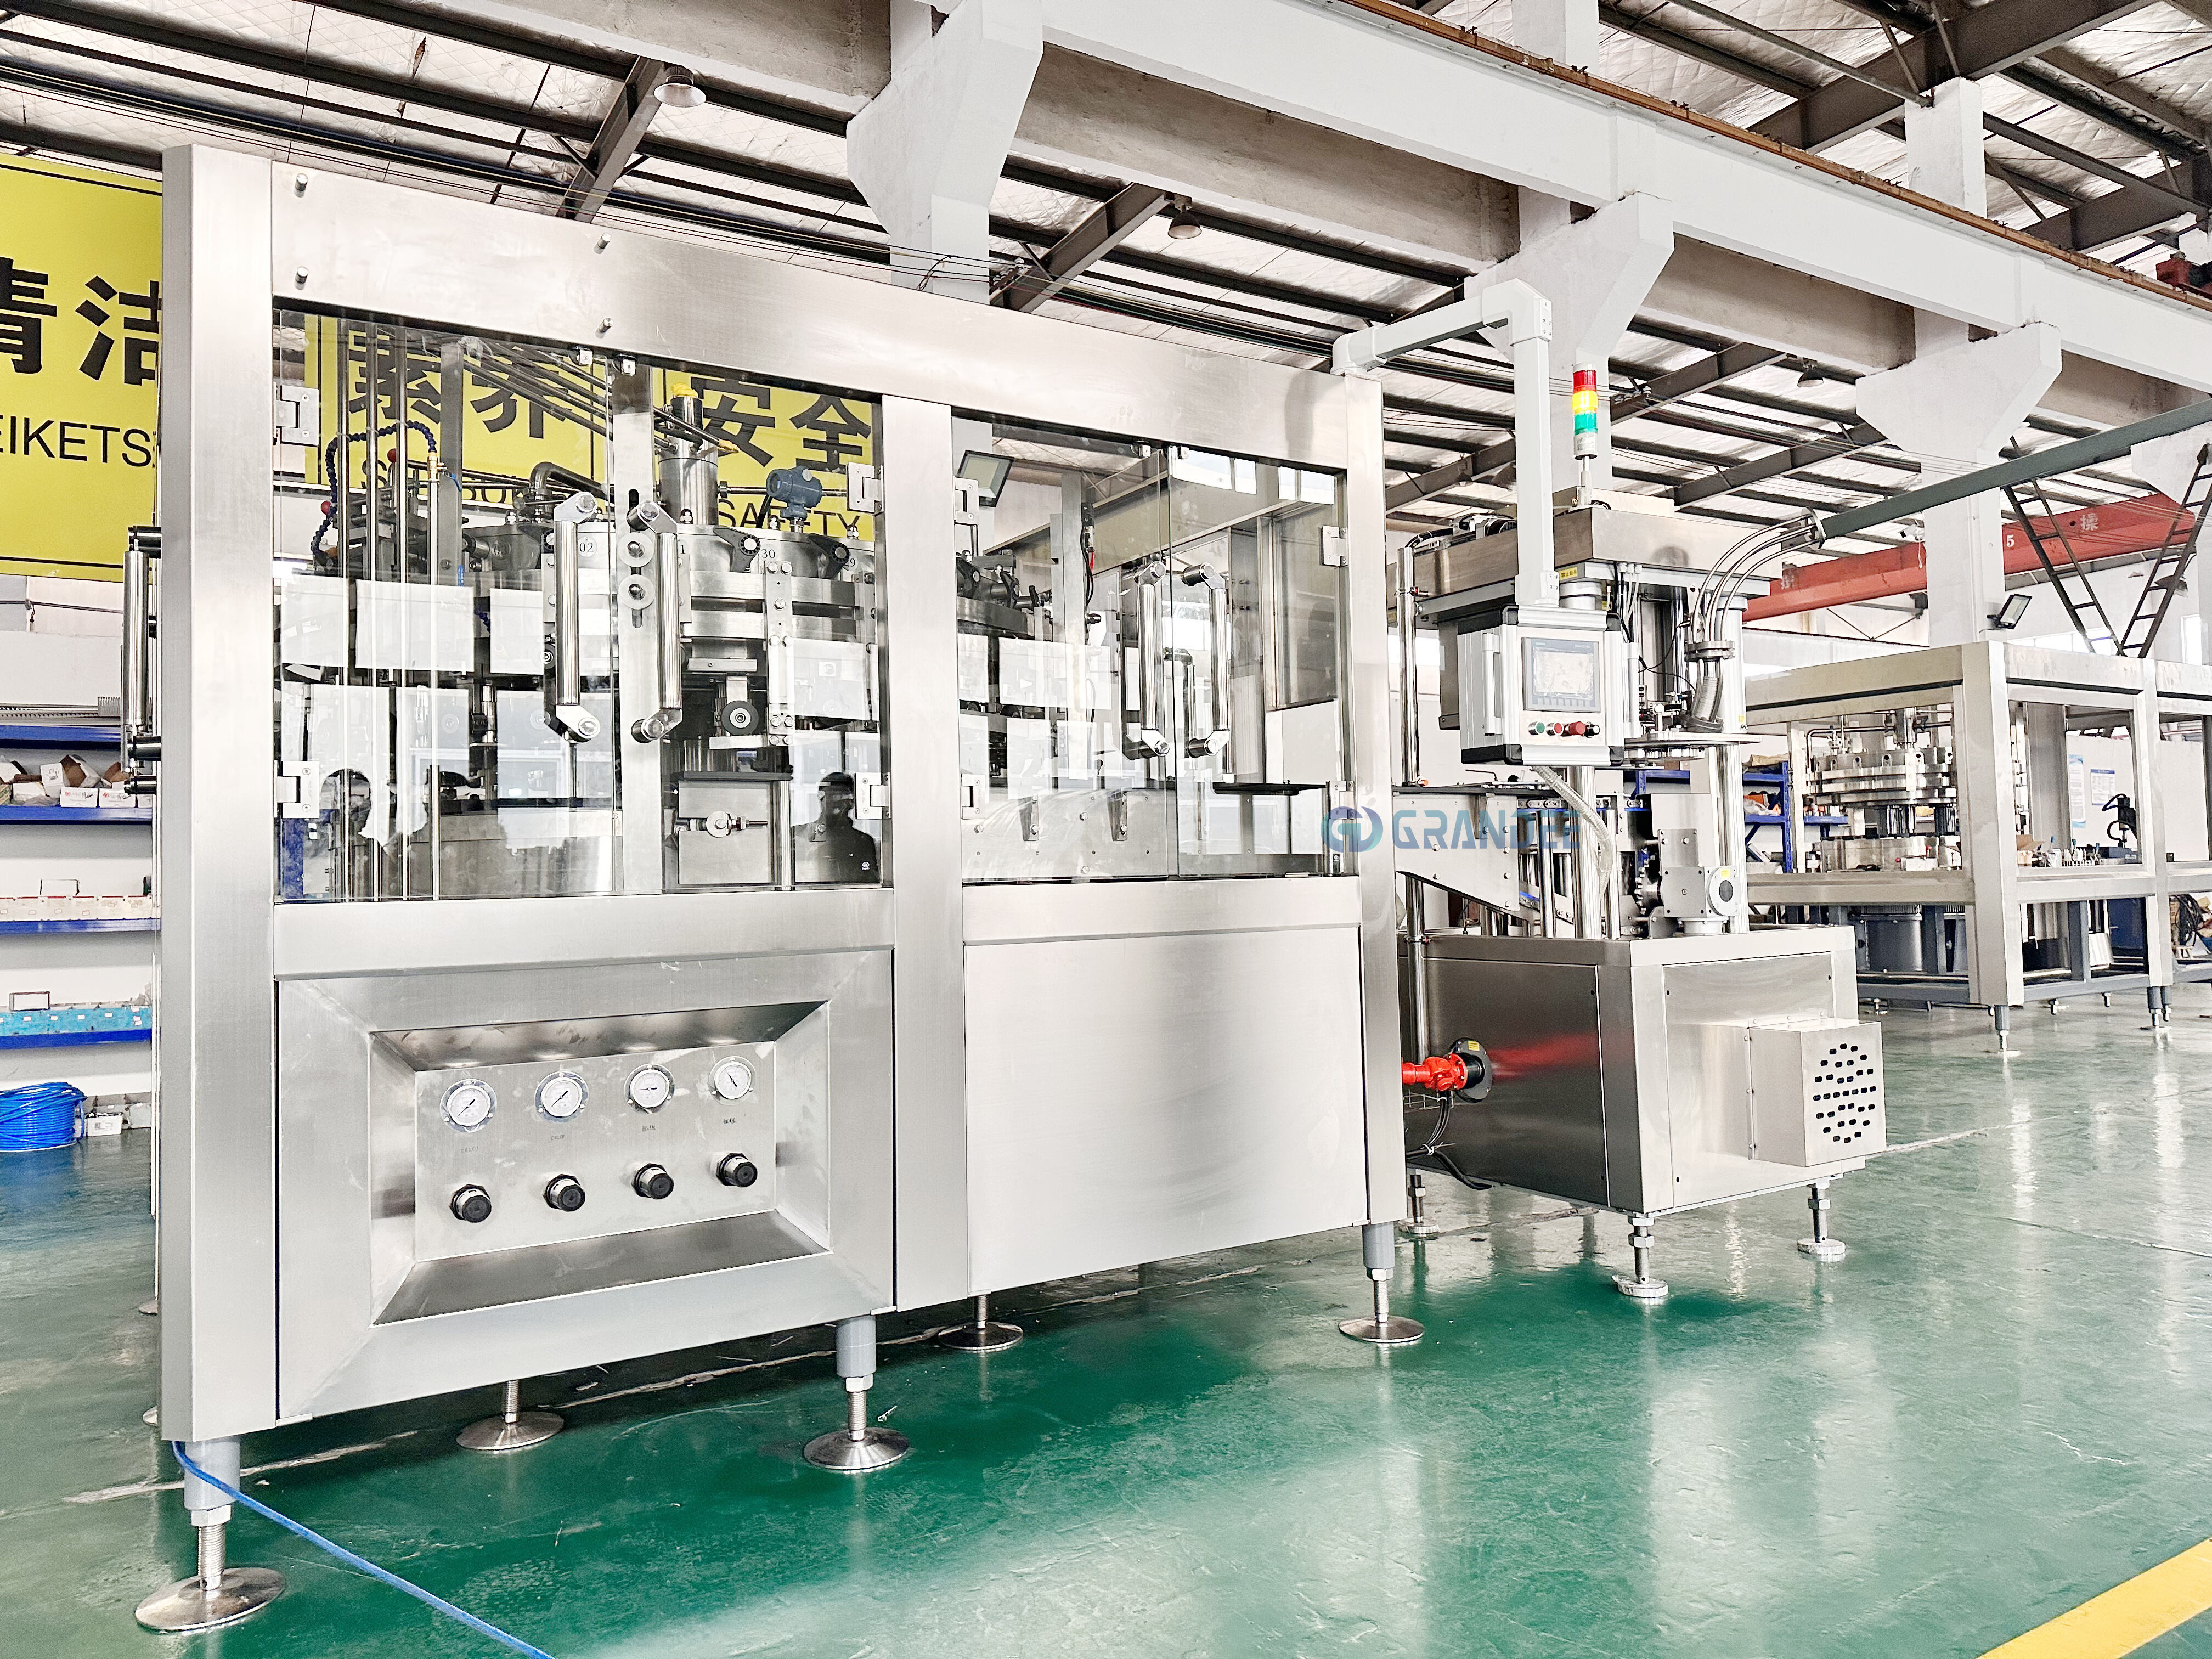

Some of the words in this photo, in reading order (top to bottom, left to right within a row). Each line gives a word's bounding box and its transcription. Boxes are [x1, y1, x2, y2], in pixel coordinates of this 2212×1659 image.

[691, 377, 871, 474] 安全
[0, 414, 151, 467] IKETS
[579, 542, 594, 552] 02
[2006, 534, 2015, 548] 5
[761, 549, 775, 558] 30
[845, 558, 856, 567] 9
